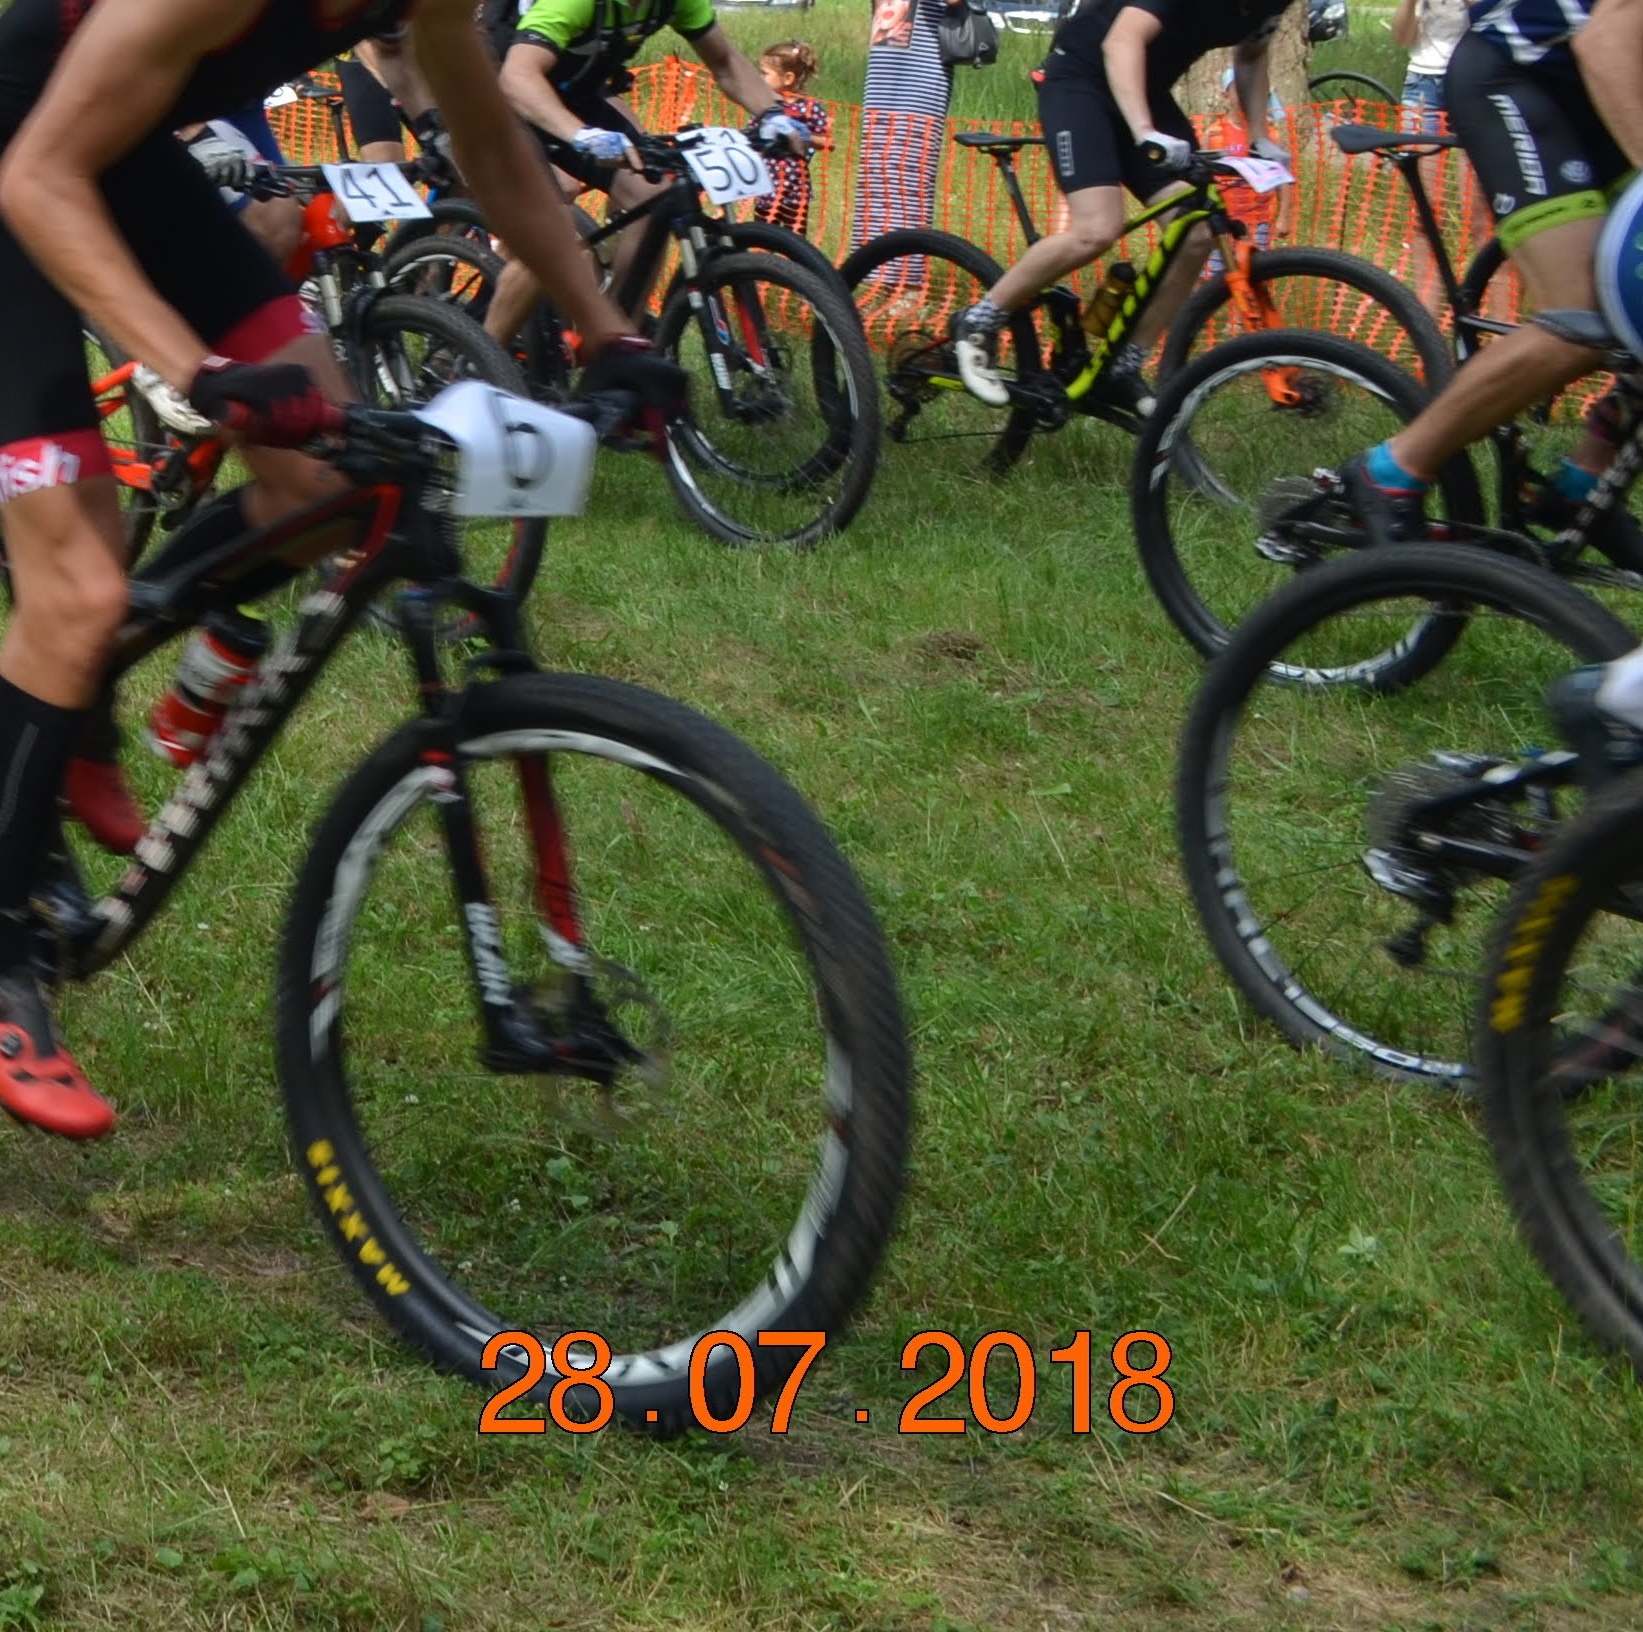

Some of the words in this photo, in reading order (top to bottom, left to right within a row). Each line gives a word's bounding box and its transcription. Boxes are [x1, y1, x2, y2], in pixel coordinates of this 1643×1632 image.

[1486, 93, 1547, 196] MERIDA
[340, 167, 414, 208] 41
[695, 146, 758, 192] 50
